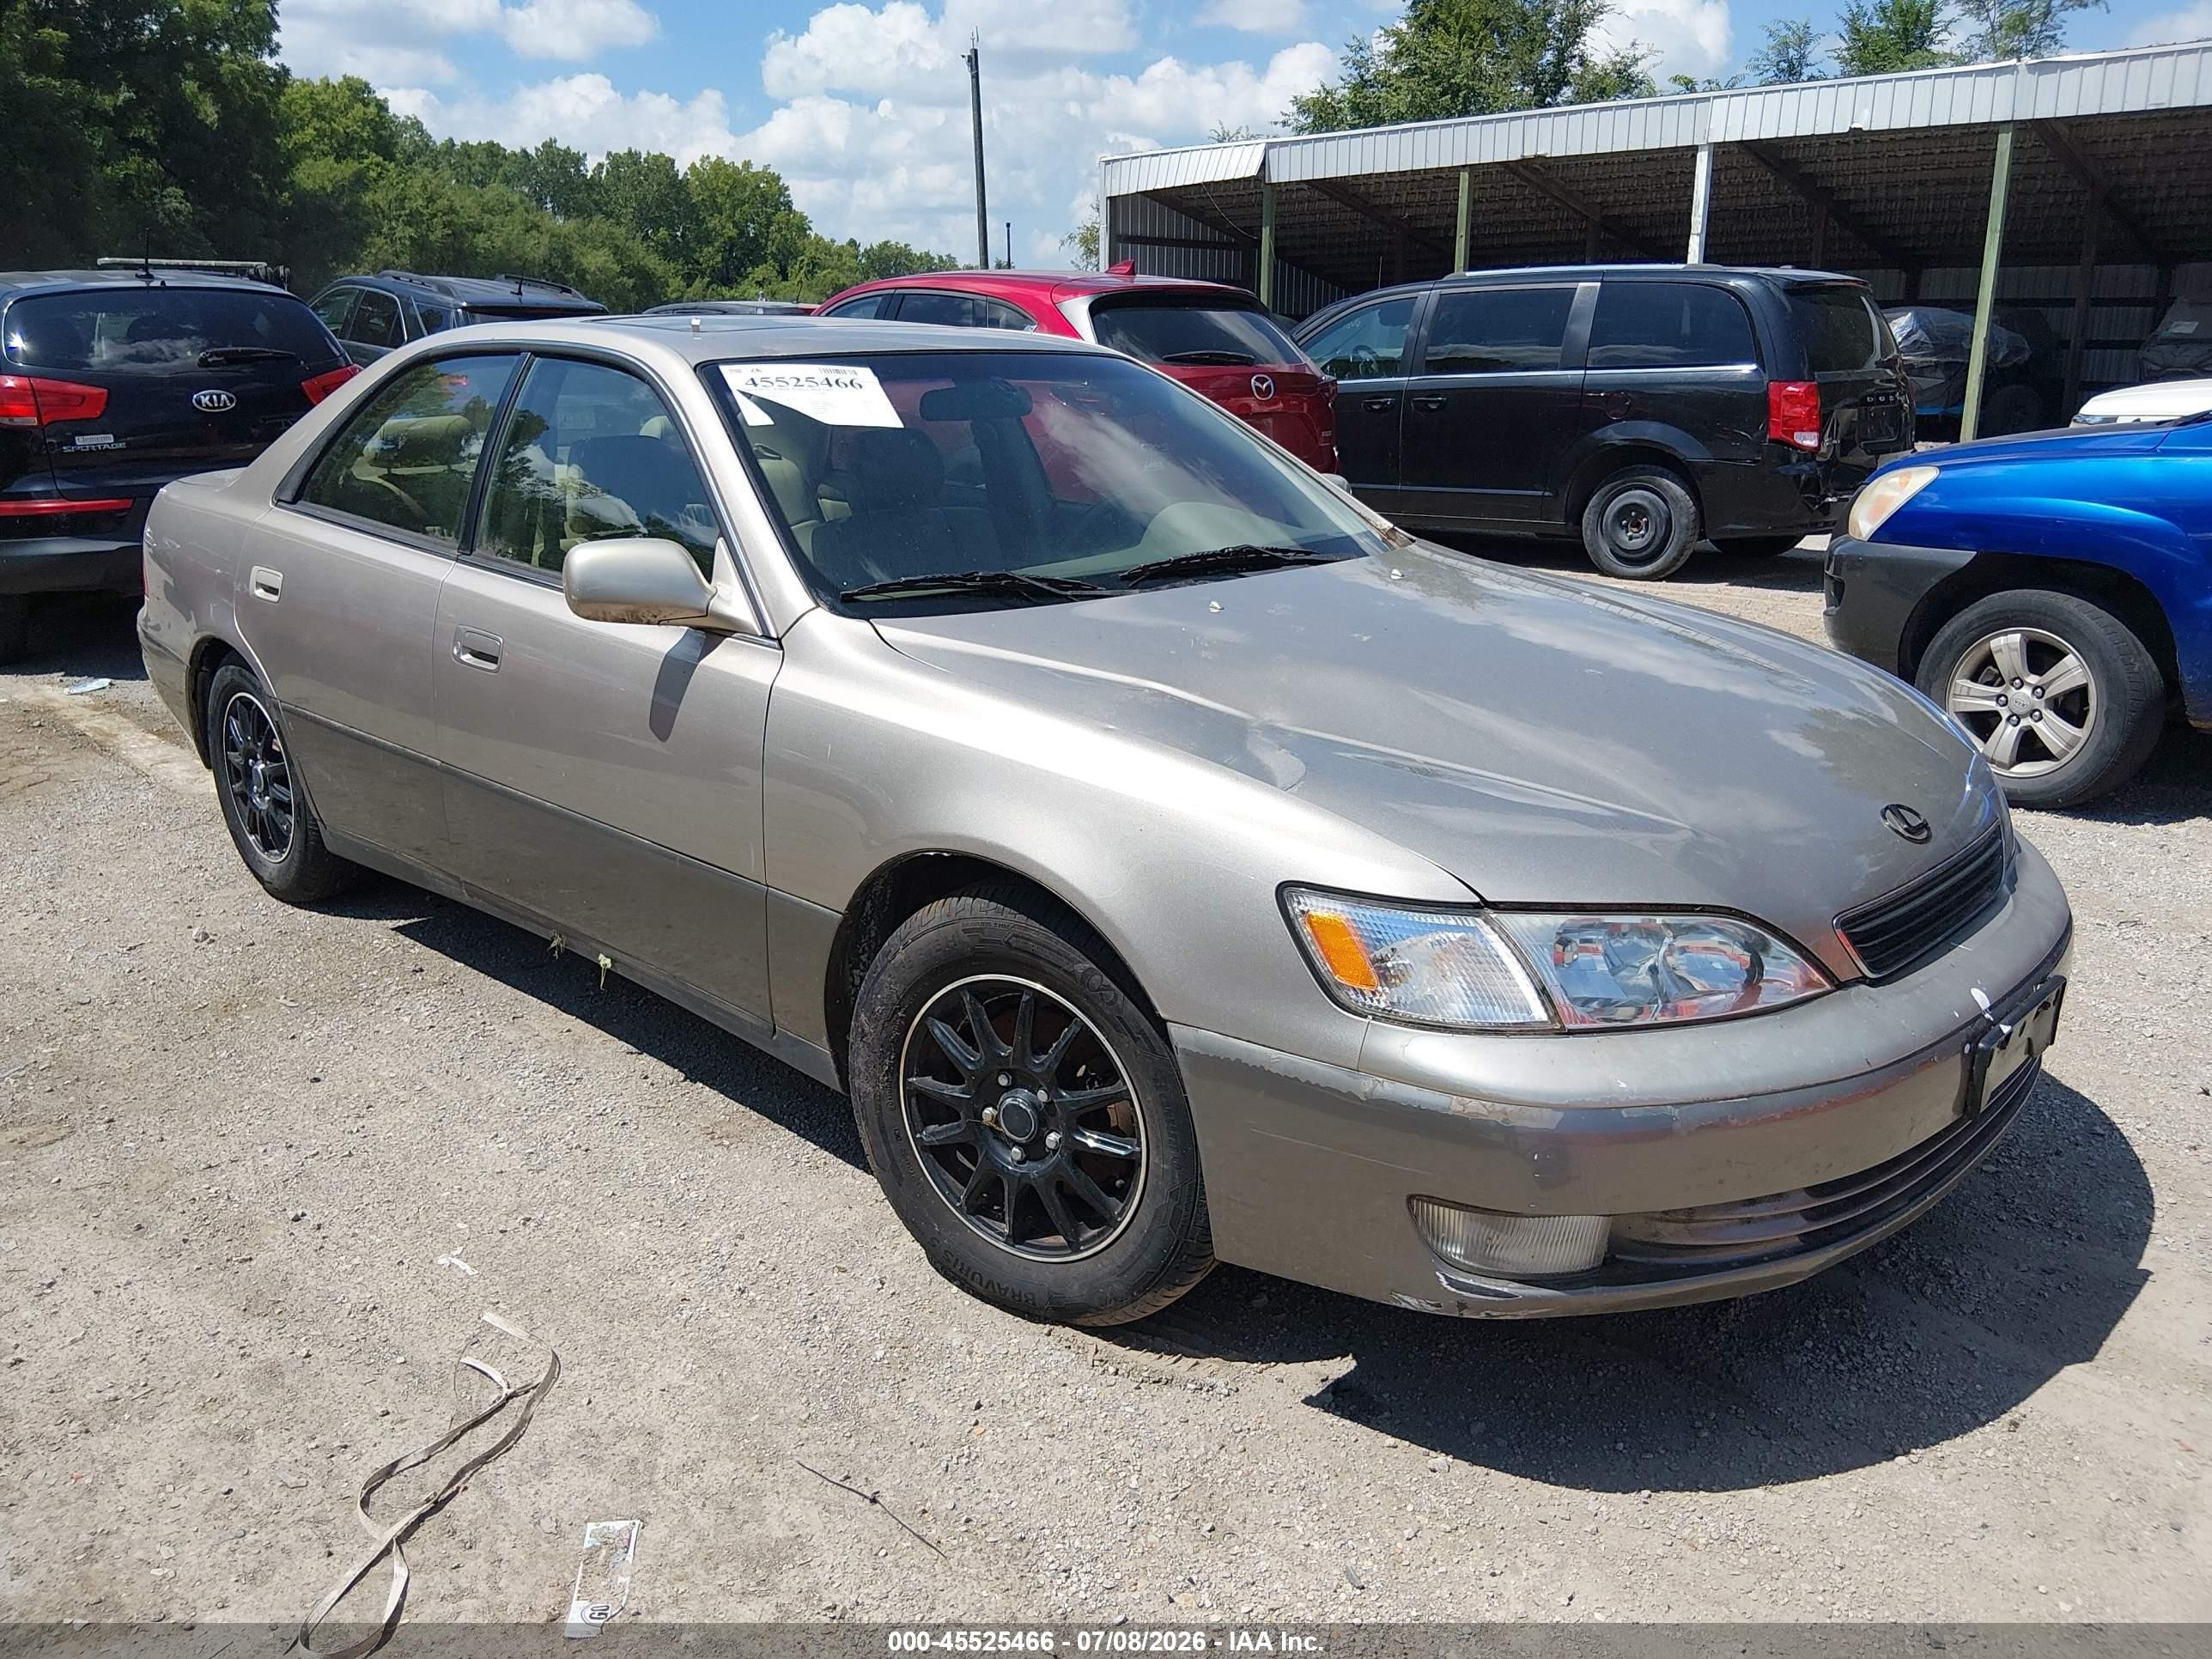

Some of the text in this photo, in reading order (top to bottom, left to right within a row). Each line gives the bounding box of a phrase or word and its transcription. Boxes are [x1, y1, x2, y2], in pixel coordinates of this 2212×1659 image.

[744, 376, 863, 390] 45525466
[200, 394, 231, 408] KIA
[62, 442, 126, 453] SPORTAGE
